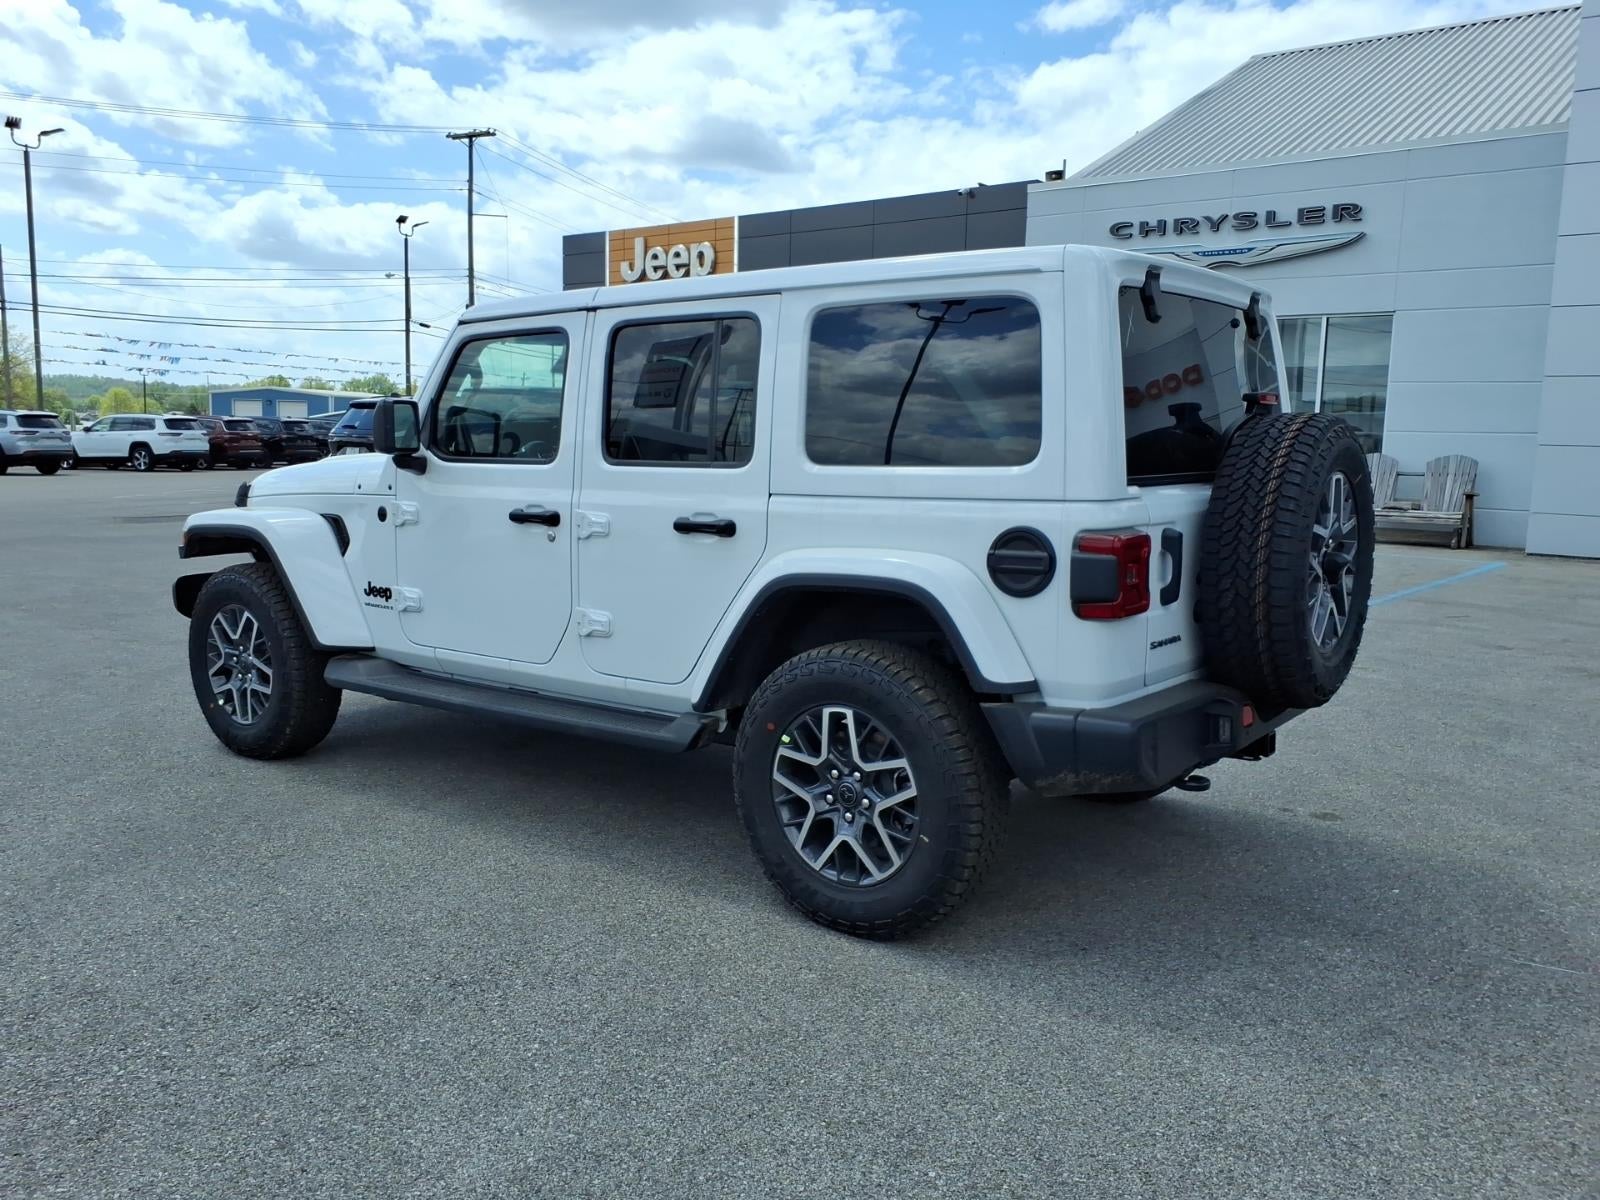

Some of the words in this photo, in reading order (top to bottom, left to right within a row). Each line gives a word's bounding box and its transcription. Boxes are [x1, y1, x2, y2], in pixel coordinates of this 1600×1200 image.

[1109, 203, 1363, 239] CHRYSLER
[620, 236, 715, 282] Jeep
[363, 580, 393, 602] Jeep
